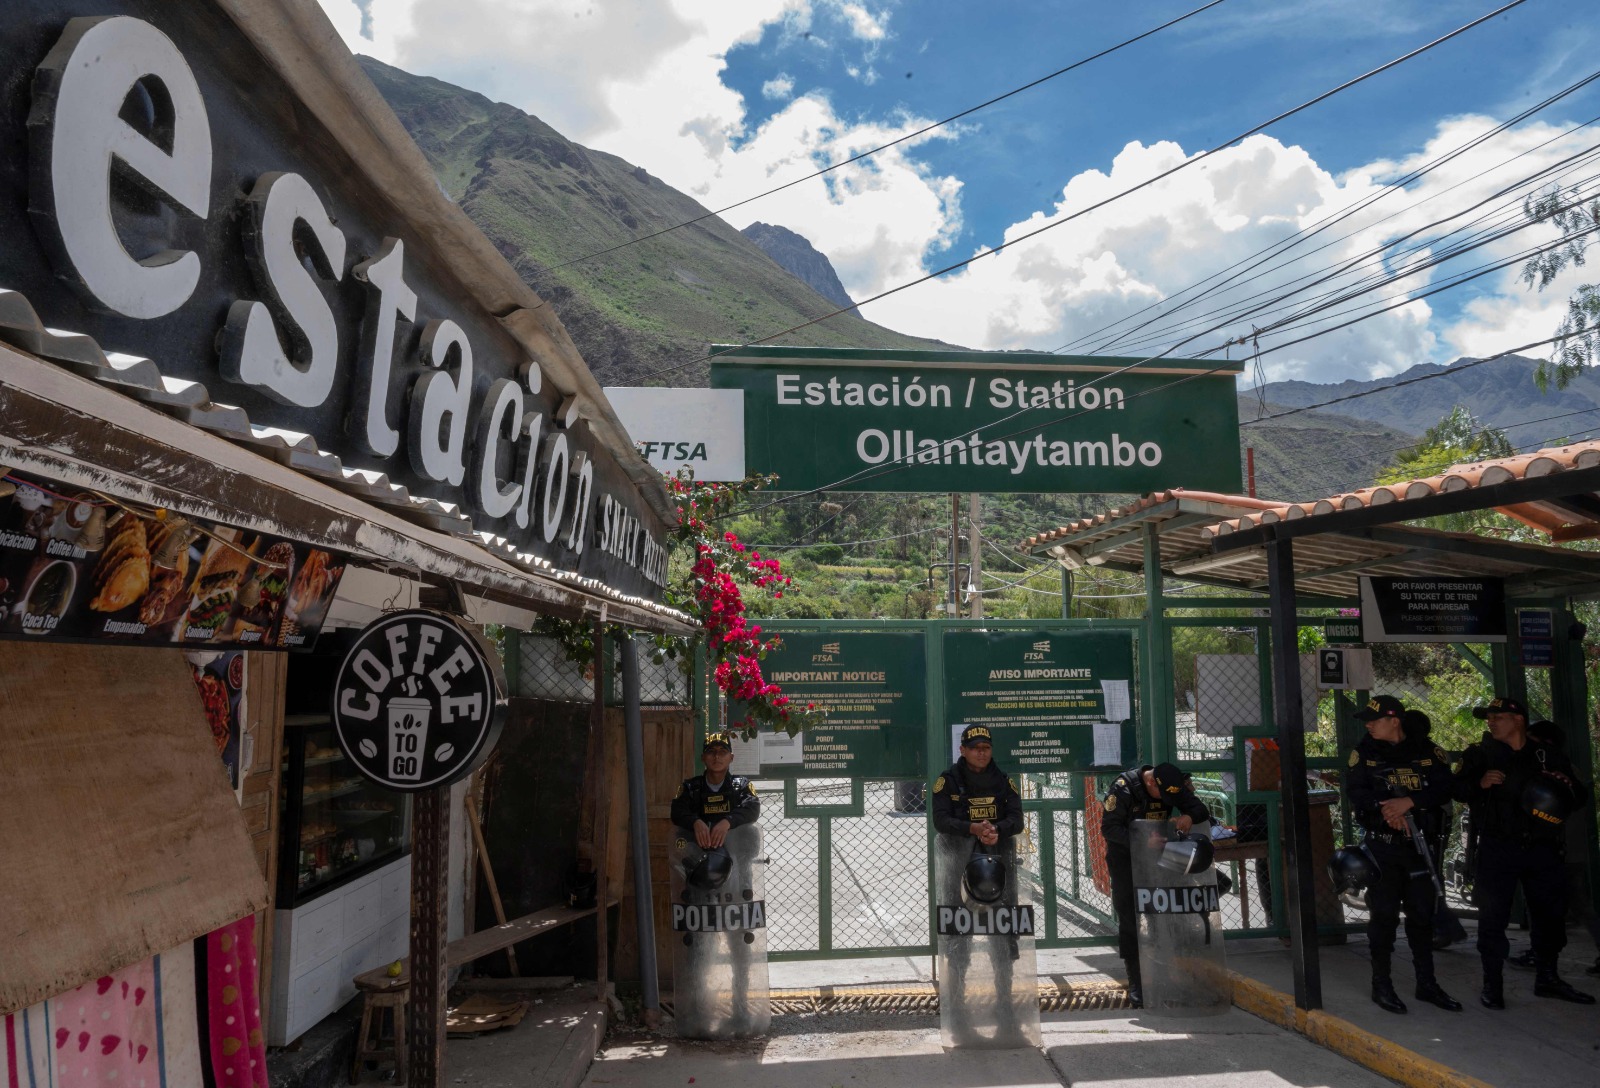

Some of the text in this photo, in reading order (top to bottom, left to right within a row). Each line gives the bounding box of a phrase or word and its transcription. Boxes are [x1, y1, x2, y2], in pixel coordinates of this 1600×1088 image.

[50, 14, 593, 554] estación
[776, 374, 1125, 410] Estación / Station
[644, 441, 708, 461] FTSA
[856, 428, 1162, 475] Ollantaytambo
[600, 493, 640, 568] SNACK
[0, 532, 37, 551] ocaccino
[1392, 582, 1483, 591] POR FAVOR PRESENTAR
[1400, 592, 1477, 601] SU TICKET DE TREN
[1430, 603, 1469, 611] INGRESAR
[22, 612, 59, 629] Coca Tea
[103, 618, 148, 635] Empanadas
[185, 625, 214, 639] Sandwich
[1326, 624, 1360, 637] INGRESO
[811, 654, 833, 662] FTSA
[1023, 652, 1044, 660] FTSA
[340, 623, 483, 724] COFFEE
[771, 671, 886, 682] IMPORTANT NOTICE
[989, 668, 1092, 679] AVISO IMPORTANTE
[985, 702, 1018, 710] PISCACUCHO
[1045, 700, 1070, 708] ESTACIÓN
[967, 727, 991, 739] POLICIA
[395, 733, 418, 753] TO
[1019, 739, 1061, 747] OLLANTAYTAMBO
[839, 752, 855, 760] TOWN
[1010, 748, 1030, 756] MACHU
[1050, 747, 1070, 755] PUEBLO
[393, 756, 418, 776] GO
[804, 762, 848, 770] HYDROELECTRIC
[1019, 755, 1062, 765] HIDROELÉCTRICA
[971, 808, 989, 818] POLICIA
[676, 840, 686, 848] 25
[1137, 887, 1218, 913] POLICIA
[672, 902, 765, 932] POLICIA
[939, 907, 1033, 934] POLICIA
